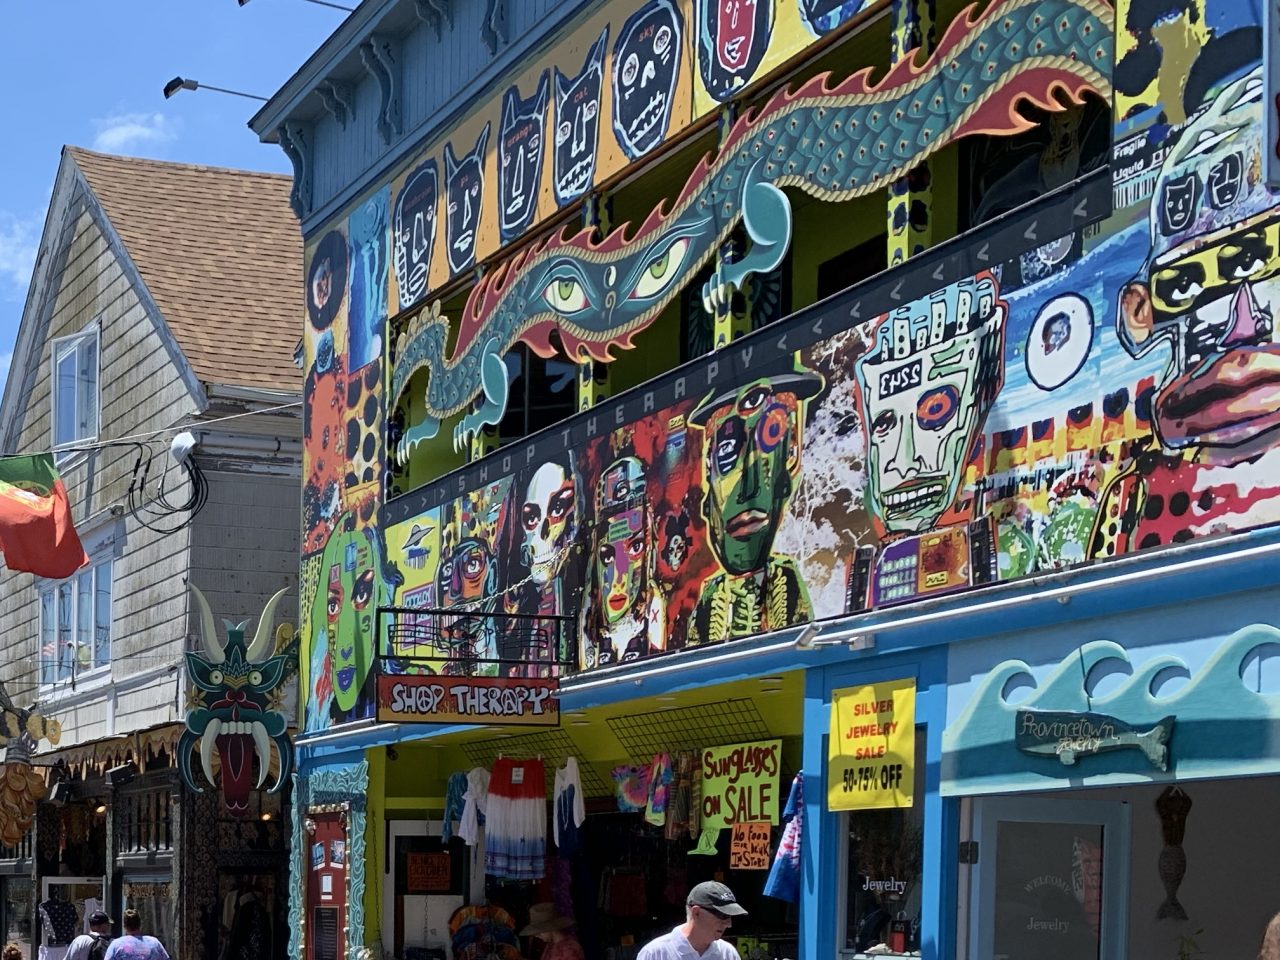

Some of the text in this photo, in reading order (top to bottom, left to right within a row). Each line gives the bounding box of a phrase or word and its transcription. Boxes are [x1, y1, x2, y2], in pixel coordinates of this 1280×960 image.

[638, 24, 655, 42] sky
[574, 87, 589, 103] cat
[1113, 137, 1147, 160] Fragile
[390, 683, 549, 716] SHOP THERAPY
[853, 699, 894, 716] SILVER
[846, 721, 898, 739] JEWELRY
[855, 745, 885, 761] SALE
[843, 764, 903, 792] 50-75% OFF
[703, 783, 772, 825] ON SALE
[862, 876, 907, 895] Jewelry
[1027, 917, 1070, 933] Jewelry
